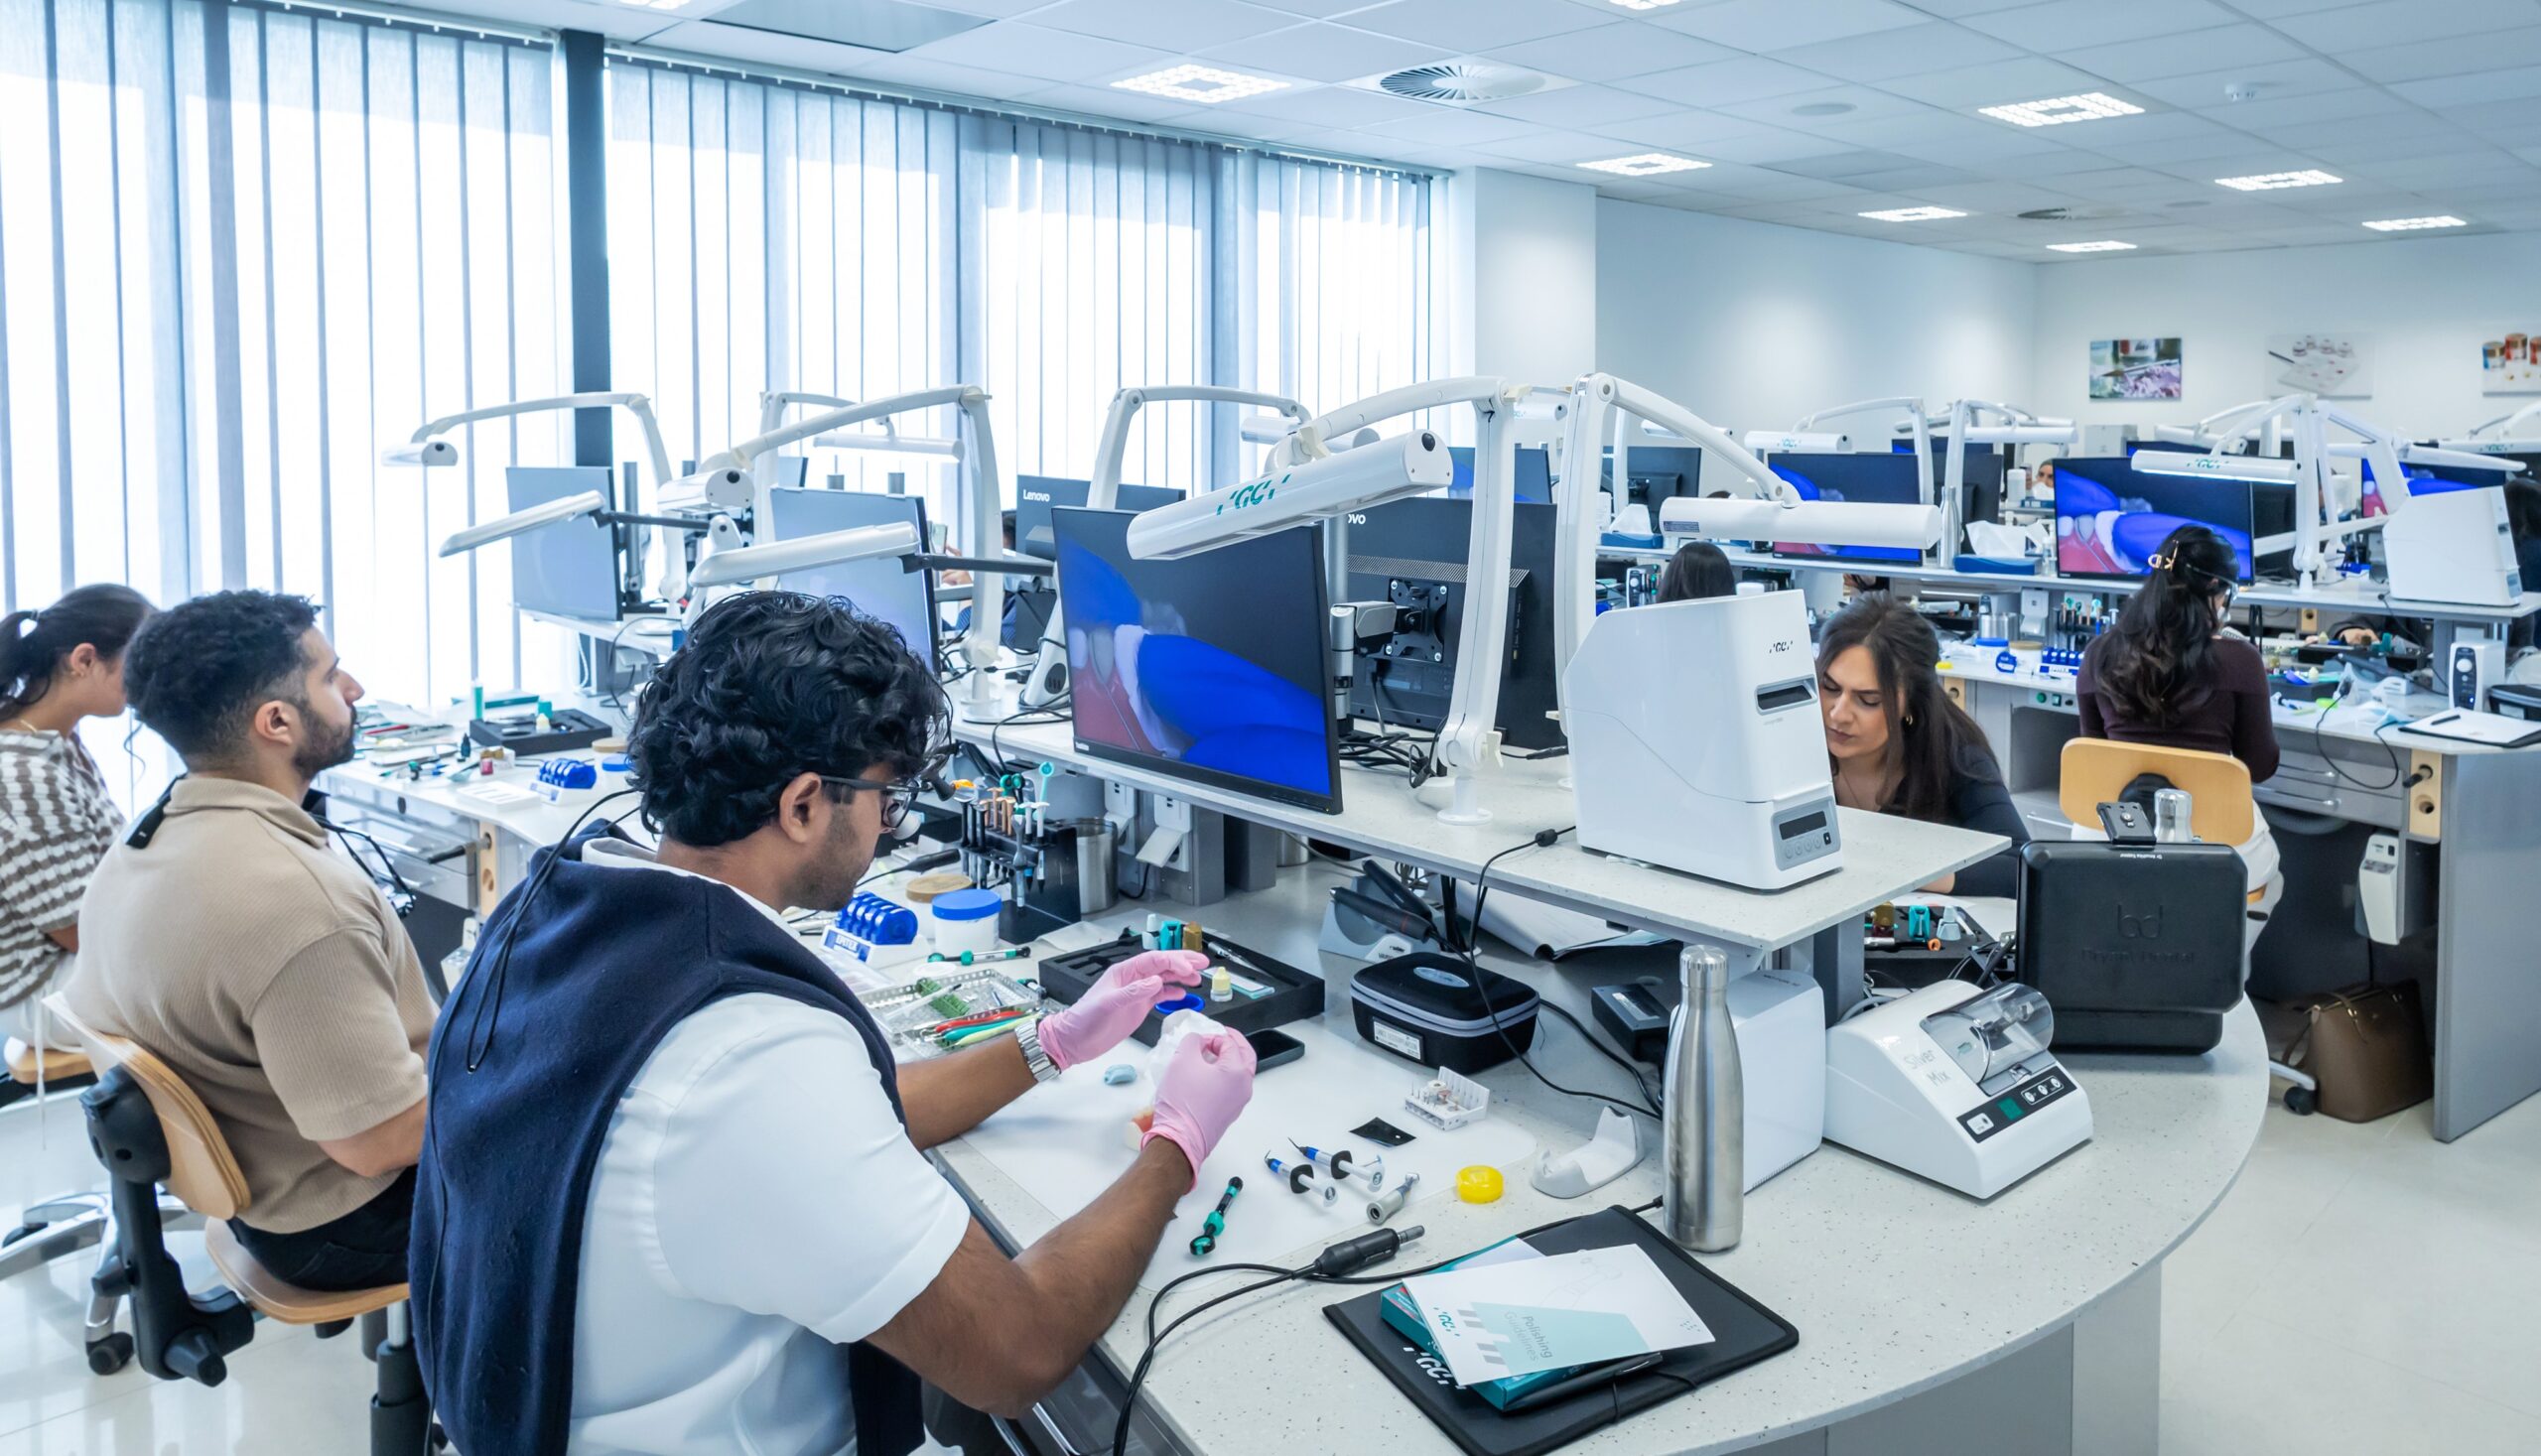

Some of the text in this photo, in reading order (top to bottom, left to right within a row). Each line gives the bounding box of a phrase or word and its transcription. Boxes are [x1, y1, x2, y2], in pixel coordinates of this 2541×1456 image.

[1022, 489, 1050, 502] Lenovo
[1926, 1071, 1952, 1088] Mix
[1504, 1310, 1538, 1363] Guidelines
[1521, 1315, 1553, 1360] Polishing
